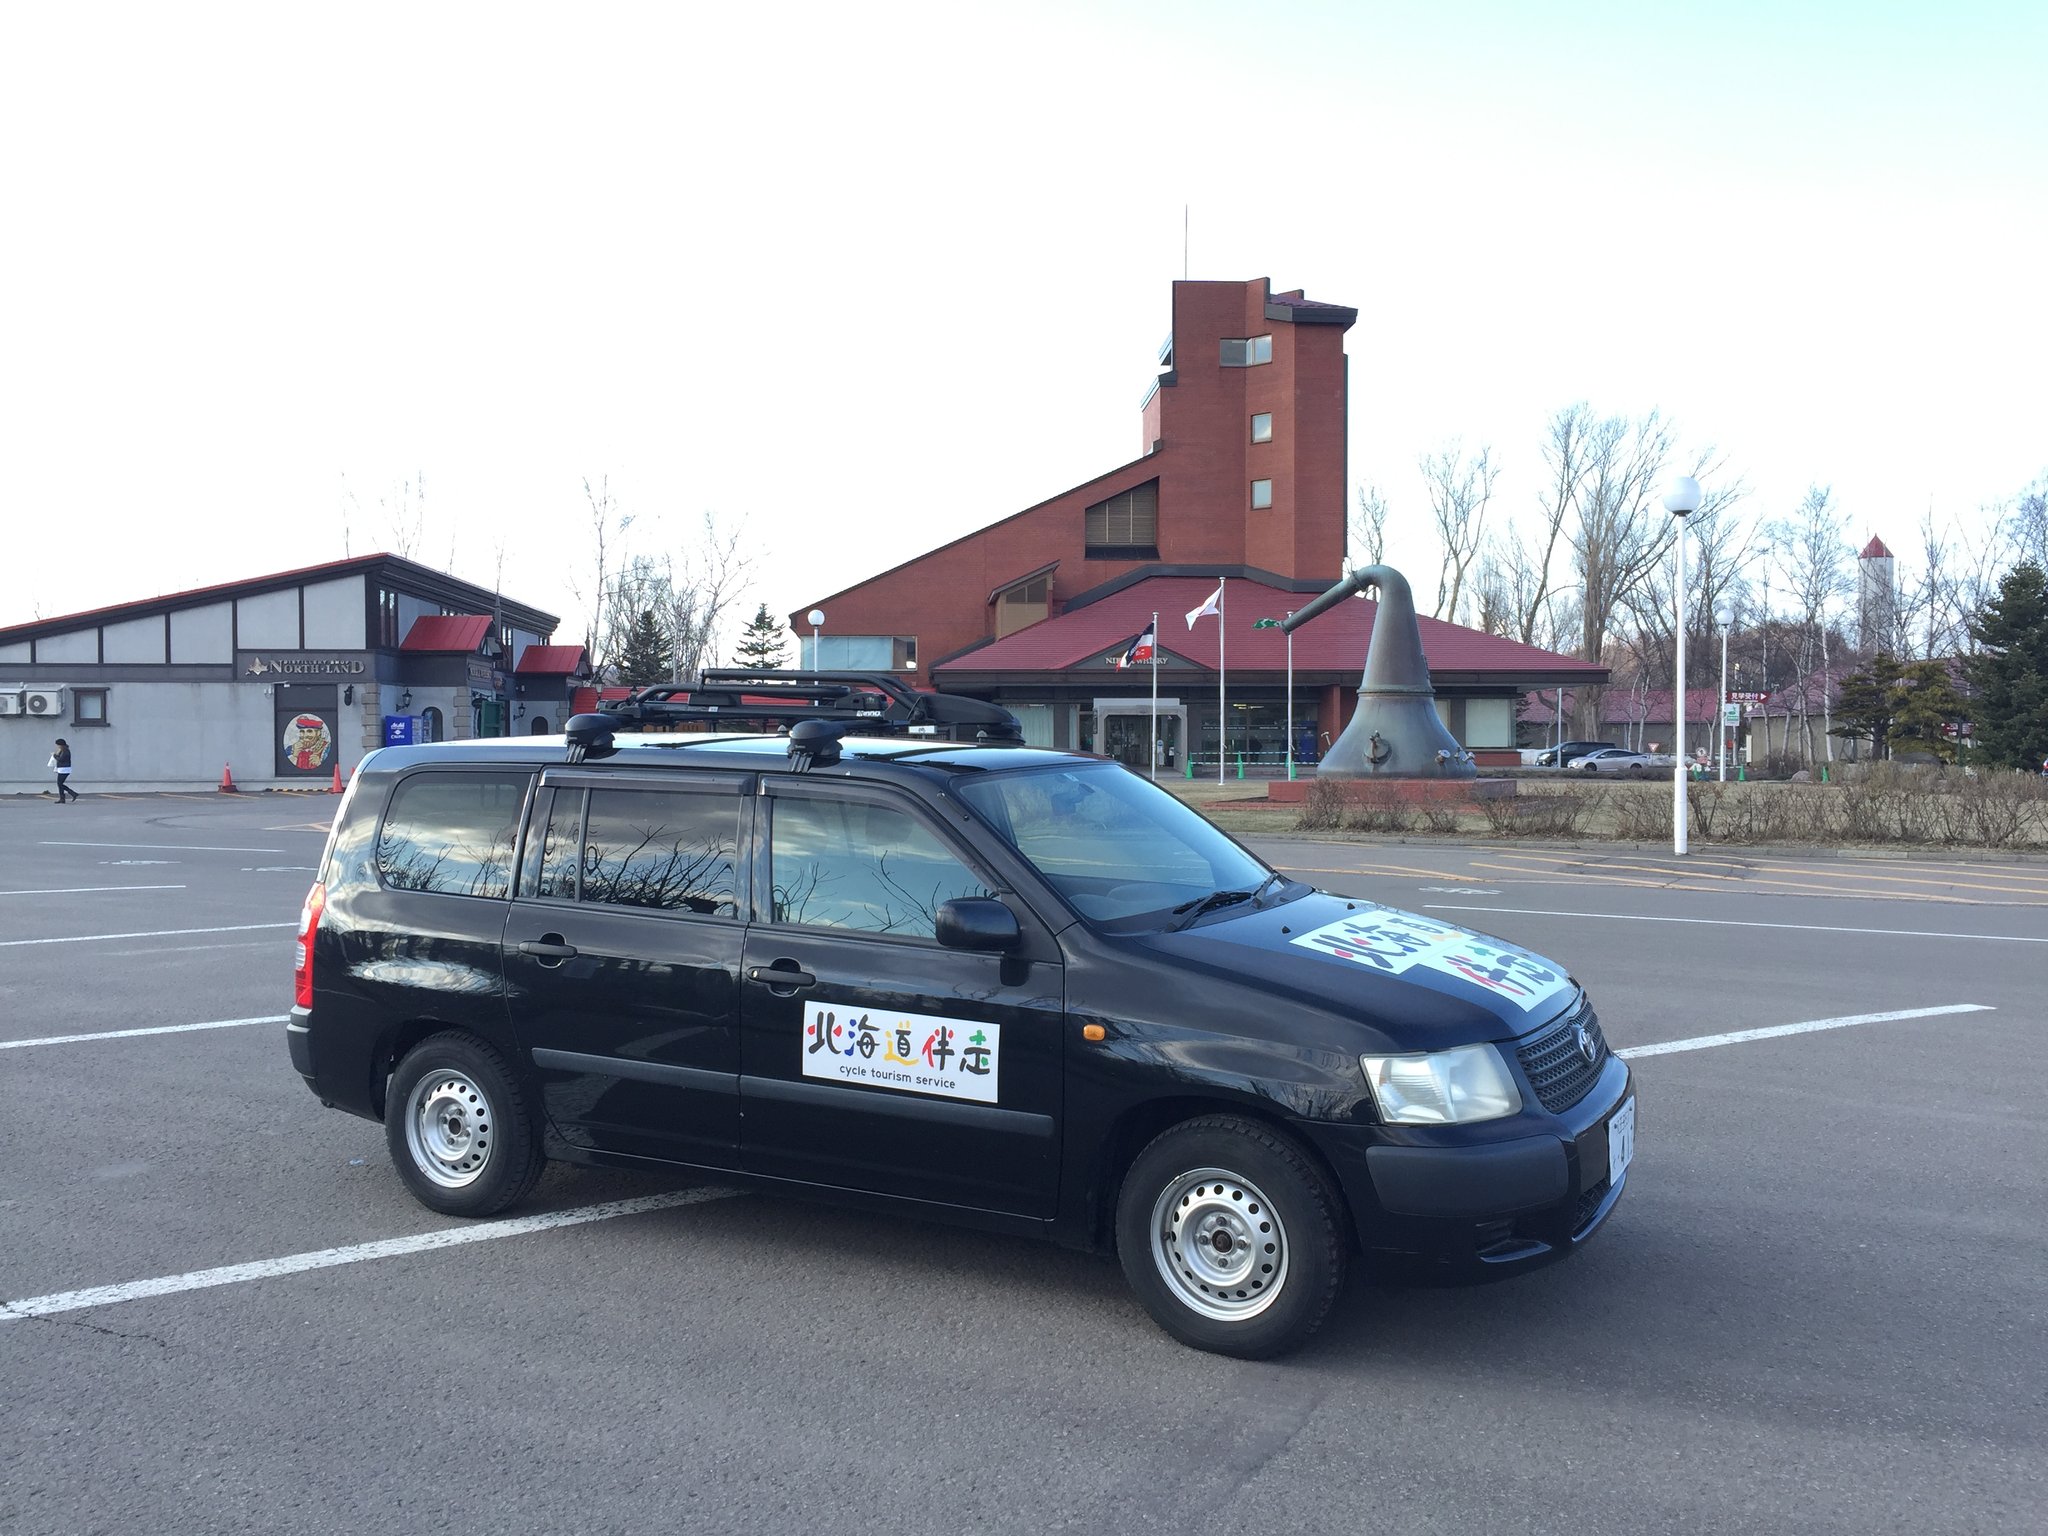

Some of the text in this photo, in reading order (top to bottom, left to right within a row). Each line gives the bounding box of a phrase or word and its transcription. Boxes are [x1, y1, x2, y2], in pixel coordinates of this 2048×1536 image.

[1731, 692, 1759, 700] 見学受付
[807, 1011, 992, 1076] 北海道伴走
[839, 1064, 956, 1090] cycle tourism service
